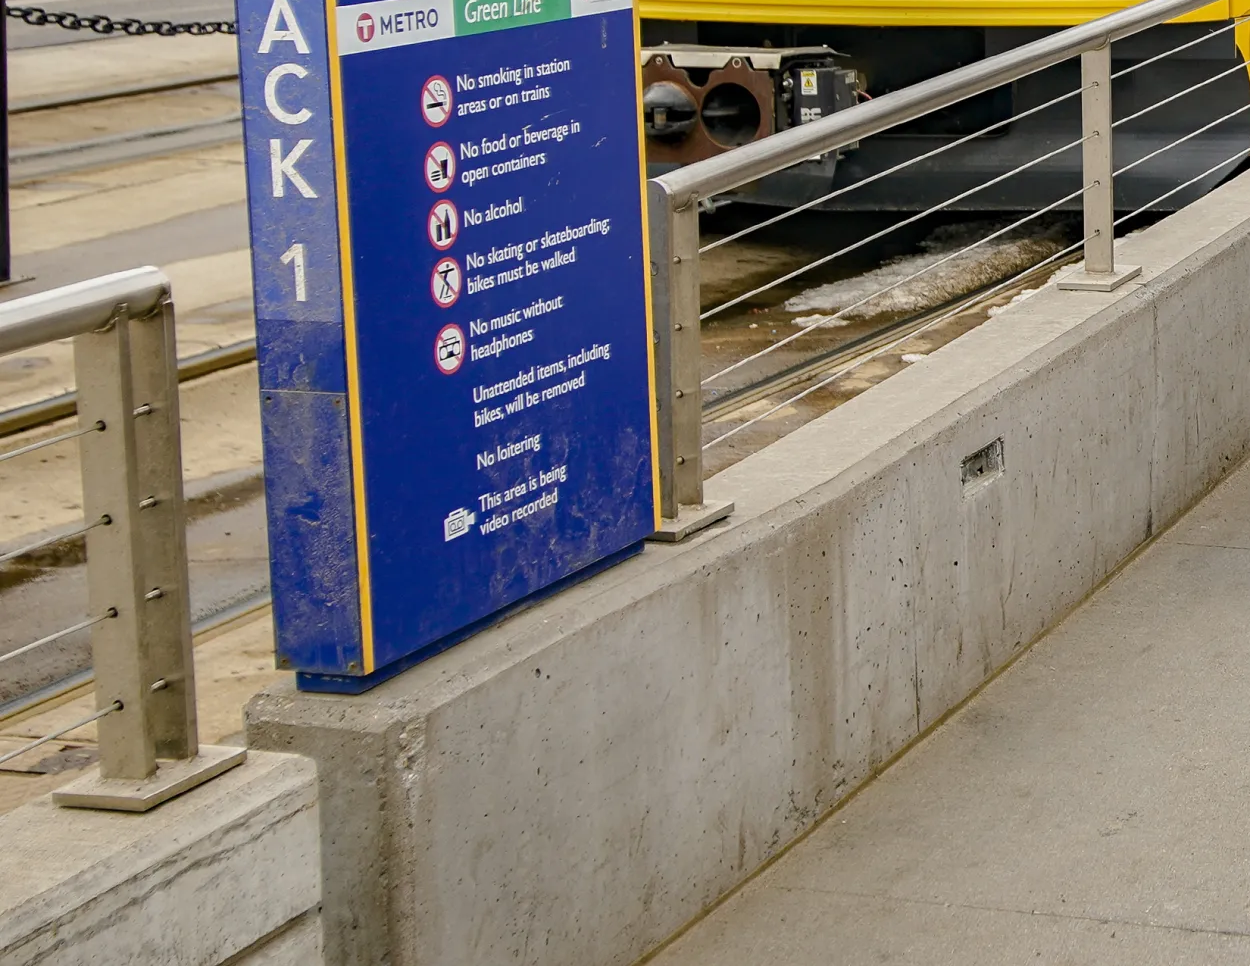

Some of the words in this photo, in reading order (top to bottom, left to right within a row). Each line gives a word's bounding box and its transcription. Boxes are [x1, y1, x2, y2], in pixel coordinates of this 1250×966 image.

[380, 8, 439, 36] METRO
[456, 74, 476, 93] No
[478, 67, 522, 86] smoking
[523, 64, 534, 79] in
[536, 58, 571, 77] station
[457, 101, 487, 117] areas
[489, 96, 502, 110] or
[505, 93, 519, 106] on
[521, 85, 551, 103] trains
[460, 141, 479, 160] No
[481, 133, 506, 156] food
[509, 134, 522, 149] or
[524, 123, 569, 143] beverage
[571, 119, 581, 134] in
[461, 167, 489, 187] open
[491, 152, 547, 177] containers
[463, 209, 483, 228] No
[485, 196, 523, 223] alcohol
[279, 242, 306, 302] 1
[466, 254, 485, 271] No
[487, 243, 523, 261] skating
[525, 239, 539, 253] or
[467, 275, 495, 295] bikes
[497, 266, 524, 286] must
[525, 261, 539, 277] be
[541, 246, 576, 271] walked
[469, 319, 488, 338] No
[490, 308, 522, 330] music
[522, 295, 564, 320] without
[470, 329, 534, 362] headphones
[472, 367, 535, 404] Unattended
[536, 360, 567, 381] items,
[567, 343, 611, 369] including
[474, 407, 505, 428] bikes,
[505, 394, 524, 415] will
[526, 391, 540, 408] be
[541, 371, 585, 402] removed
[476, 452, 495, 471] No
[497, 434, 541, 462] loitering
[478, 494, 502, 513] This
[504, 483, 527, 502] area
[528, 476, 538, 491] is
[539, 464, 567, 487] being
[479, 514, 509, 536] video
[511, 487, 559, 523] recorded
